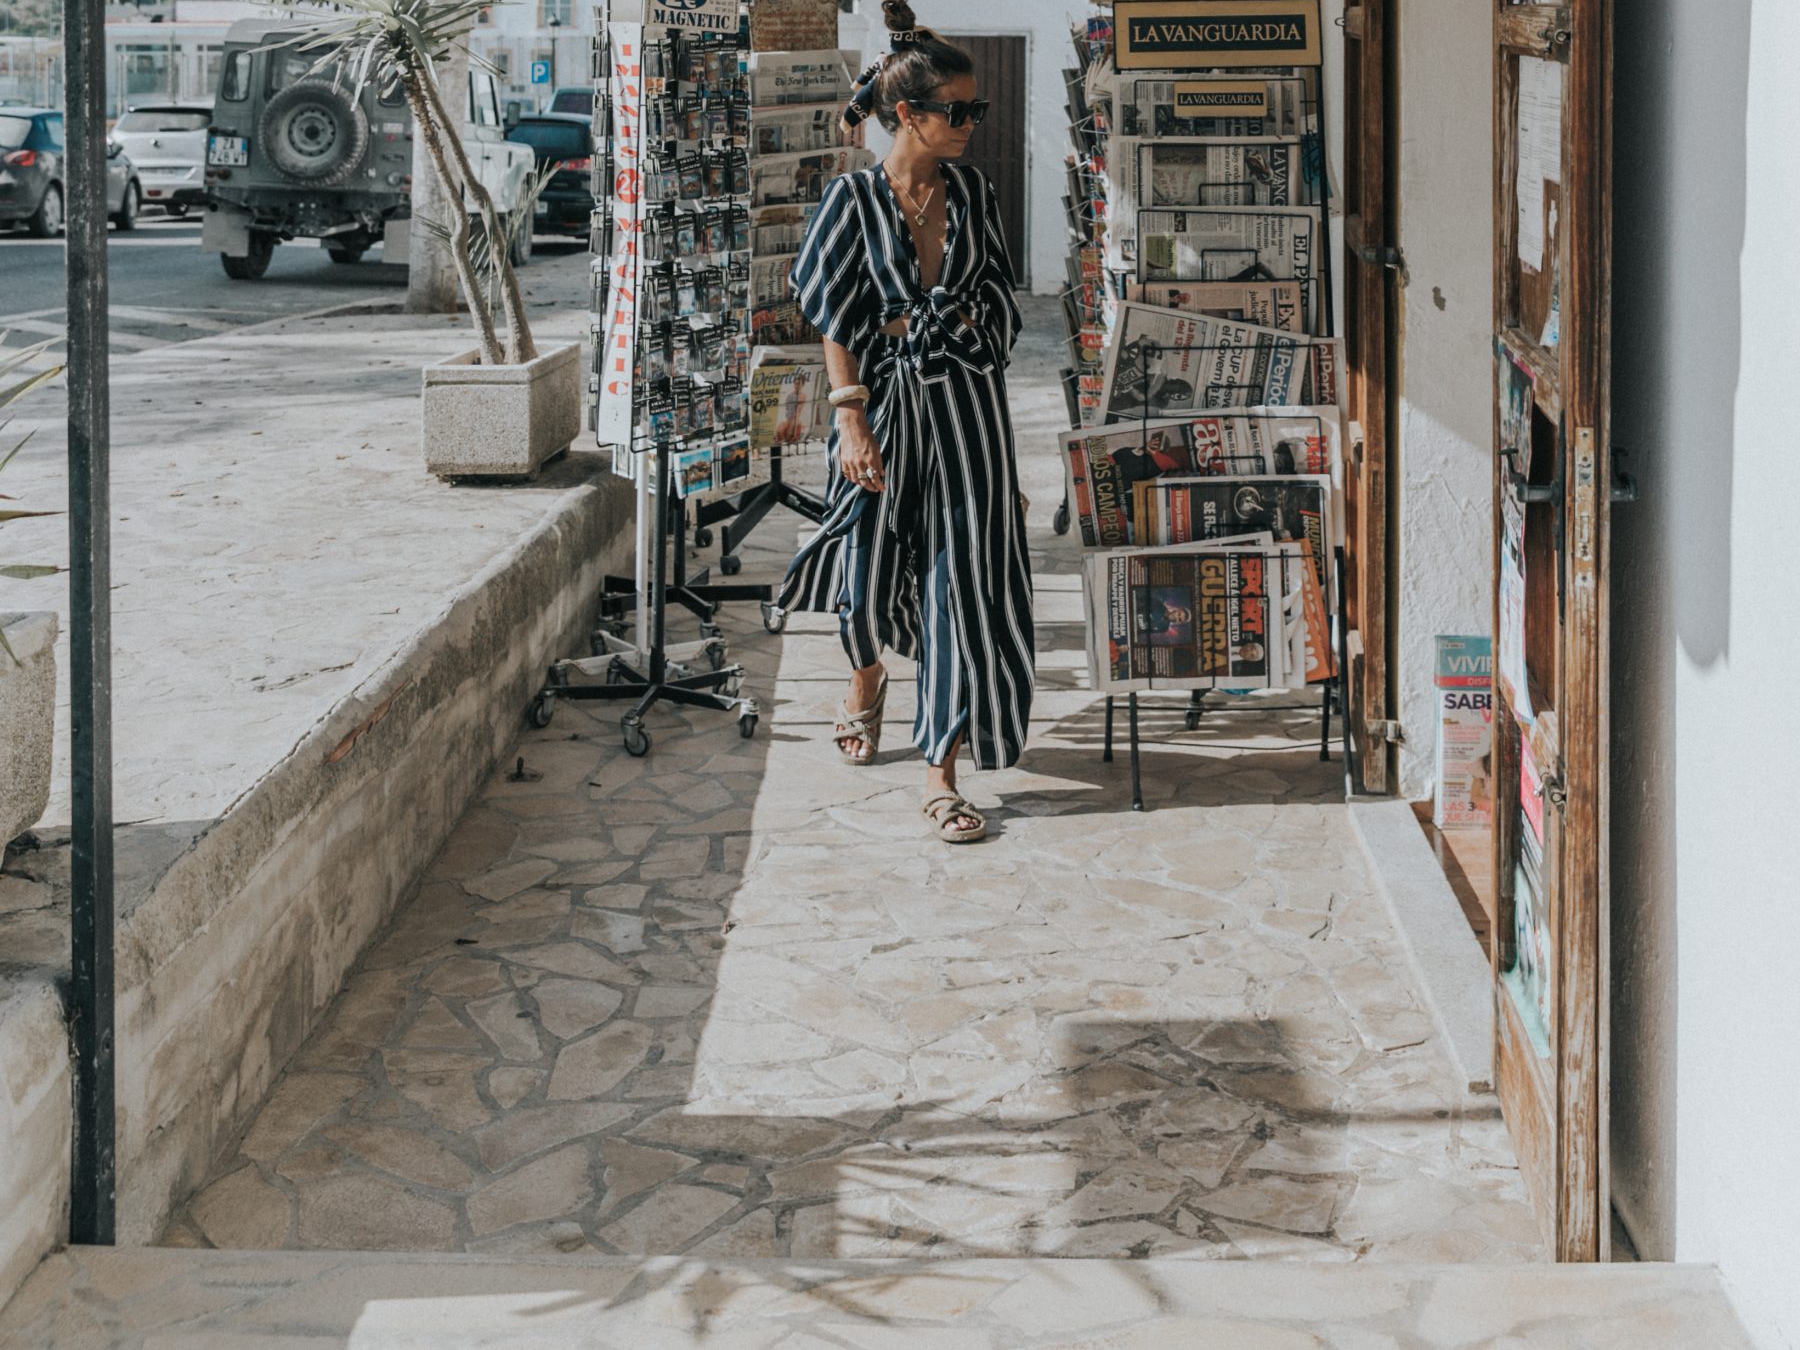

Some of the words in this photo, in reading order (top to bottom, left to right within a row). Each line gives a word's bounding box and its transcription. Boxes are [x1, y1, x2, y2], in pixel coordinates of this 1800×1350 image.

[653, 9, 730, 30] MAGNETIC
[1133, 25, 1160, 43] LA
[1162, 23, 1302, 43] VANGUARDIA
[534, 64, 546, 81] P
[787, 76, 802, 85] New
[616, 43, 641, 158] IMANES
[1193, 93, 1263, 106] VANGUARDIA
[223, 138, 235, 149] ZA
[1293, 234, 1307, 261] EL
[608, 218, 644, 395] MAGNETIC
[1233, 328, 1246, 342] La
[1203, 501, 1216, 514] SE
[1200, 559, 1228, 672] GUERRA
[1230, 616, 1240, 642] NIETO
